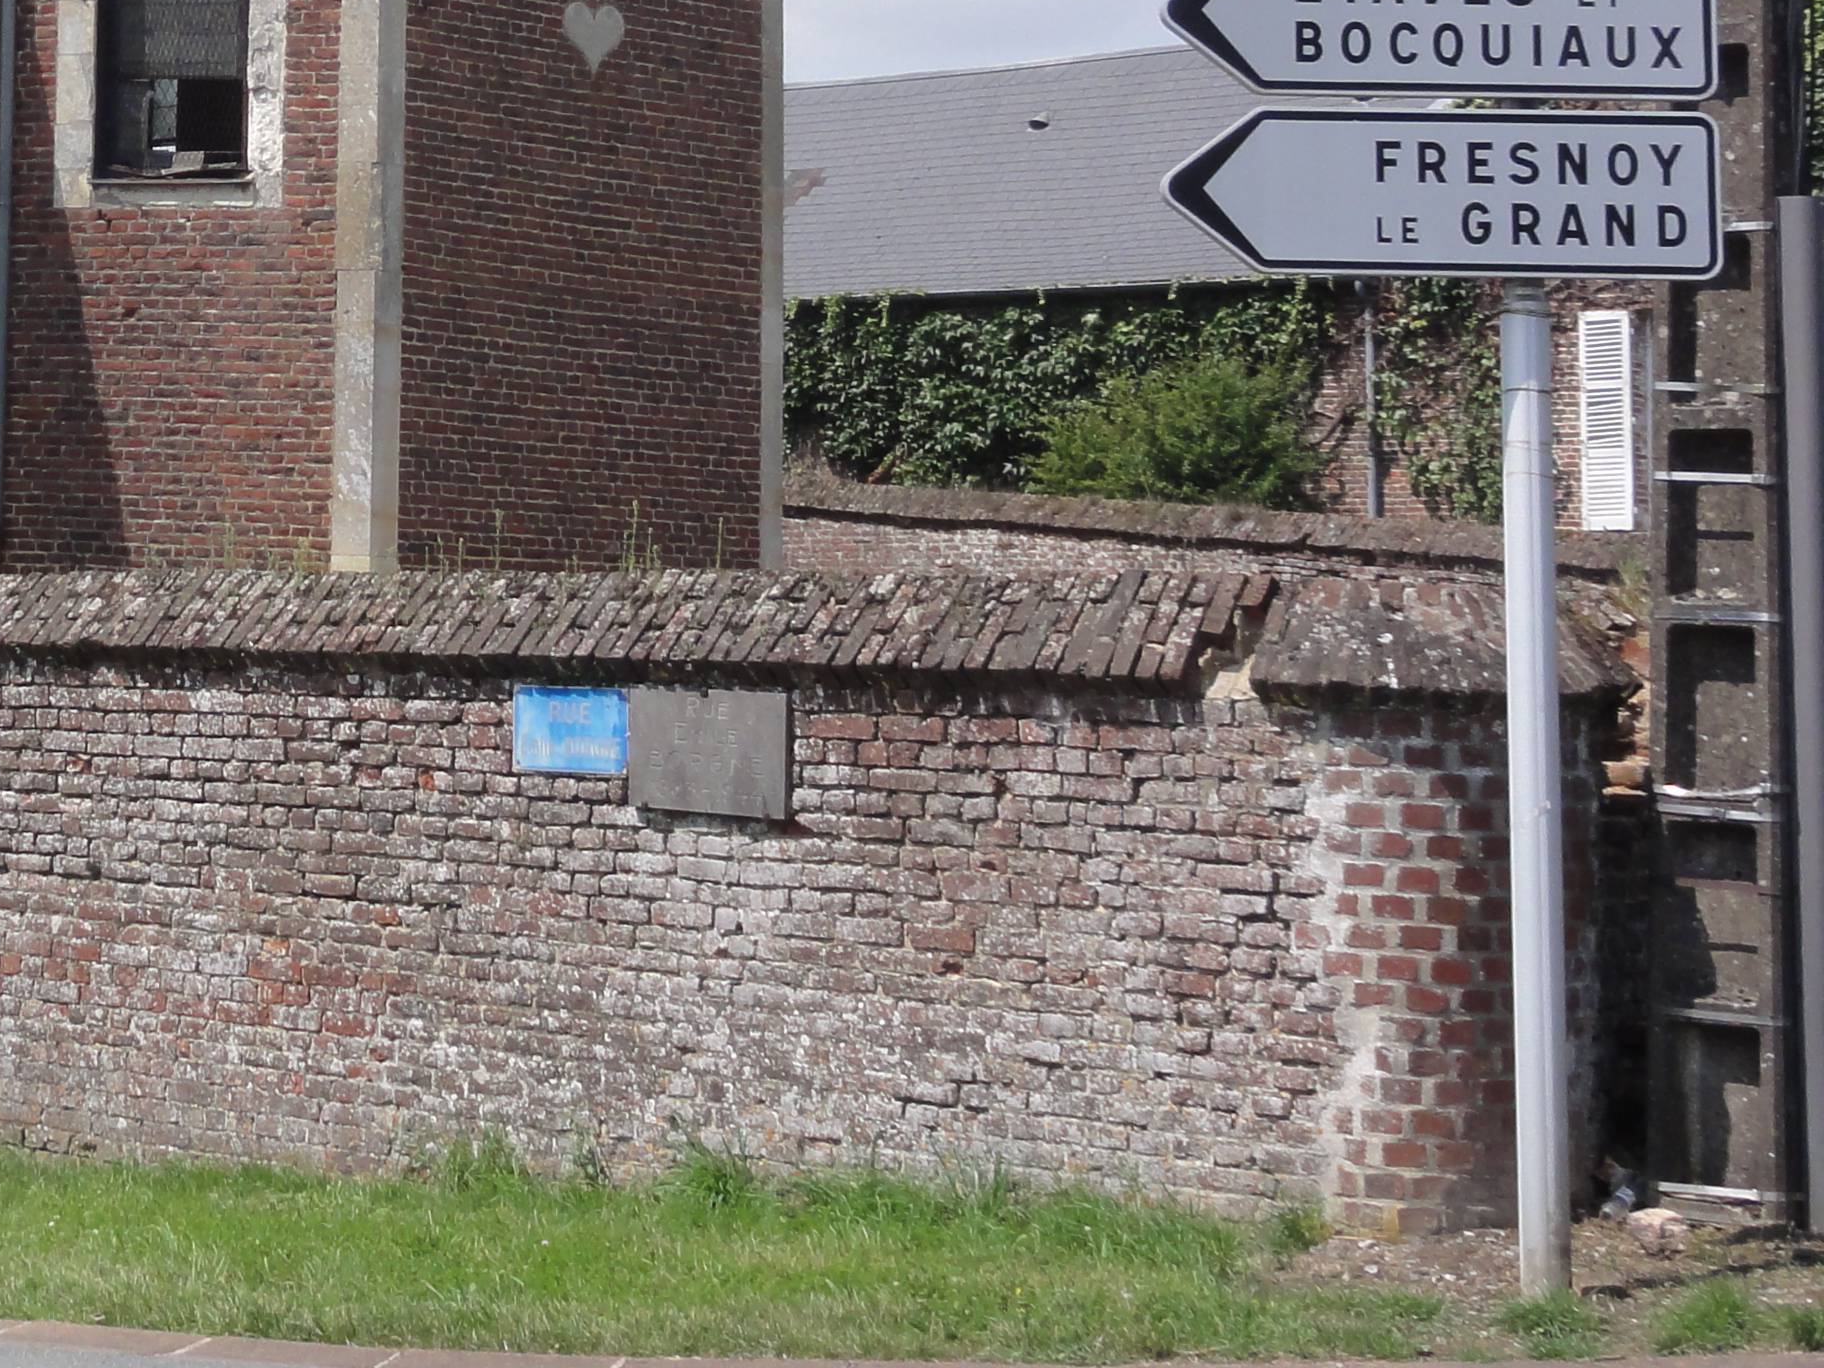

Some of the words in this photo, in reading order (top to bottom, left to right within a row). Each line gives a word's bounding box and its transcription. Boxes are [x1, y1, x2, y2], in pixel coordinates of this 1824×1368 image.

[1295, 20, 1682, 69] BOCQUIAUX
[1375, 140, 1682, 187] FRESNOY
[1377, 216, 1419, 244] LE
[1461, 201, 1687, 248] GRAND
[549, 700, 593, 725] RUE
[684, 695, 730, 721] RUE
